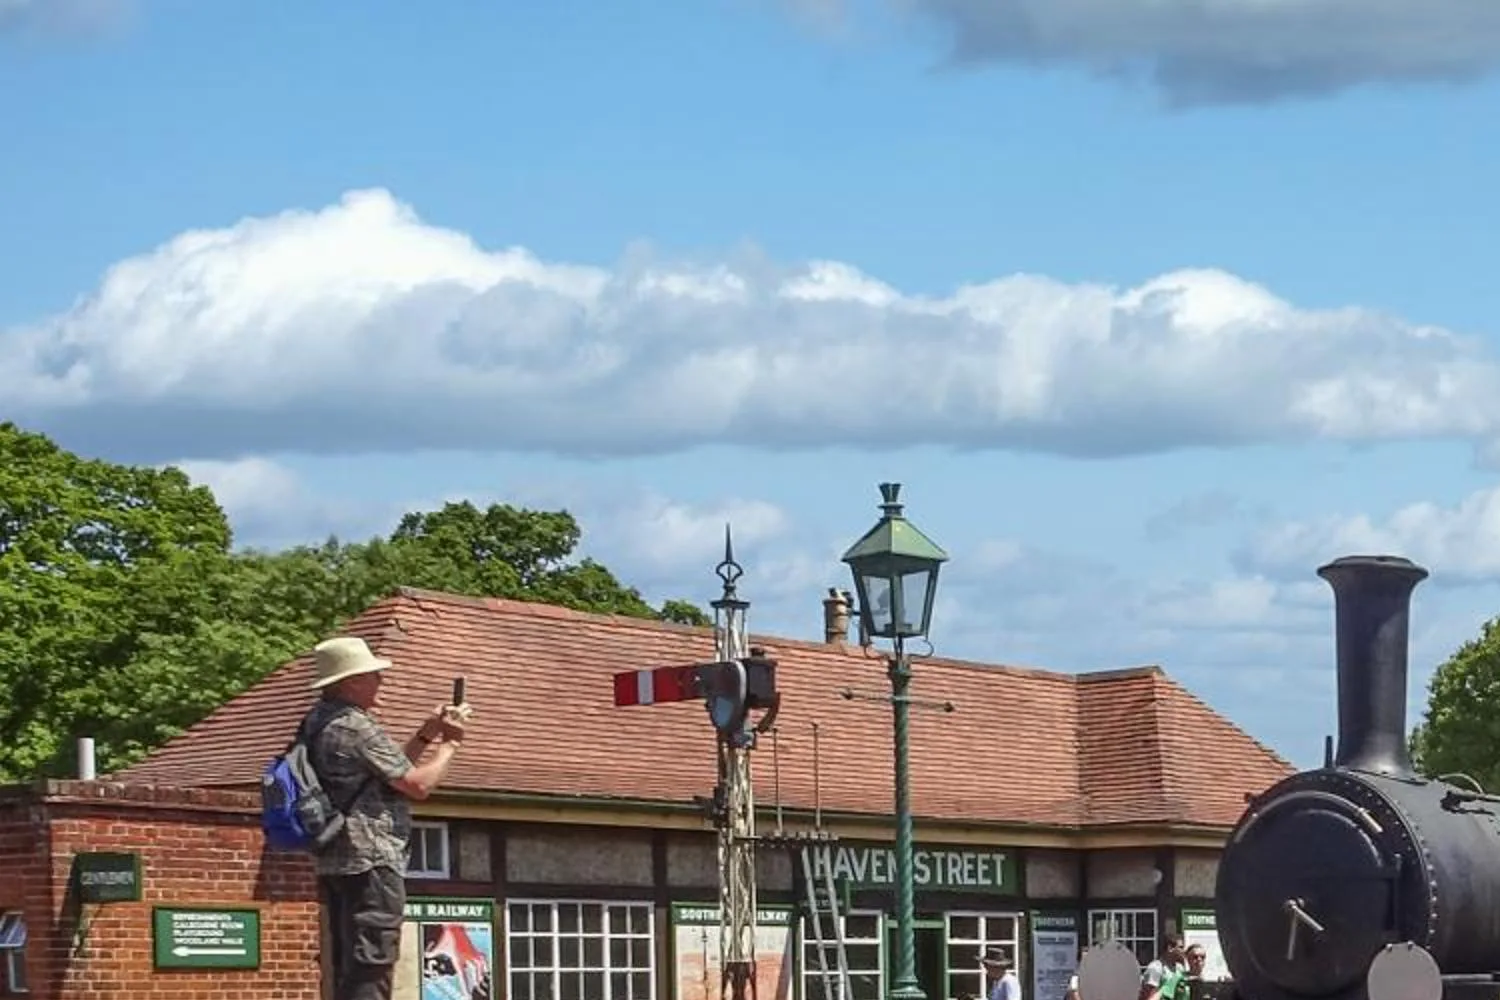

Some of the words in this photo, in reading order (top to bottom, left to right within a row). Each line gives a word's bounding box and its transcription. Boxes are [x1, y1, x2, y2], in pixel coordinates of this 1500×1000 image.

[913, 852, 1005, 885] STREET
[428, 904, 484, 917] RAILWAY
[681, 908, 721, 920] SOUTHE
[1187, 915, 1216, 925] SOUTHE
